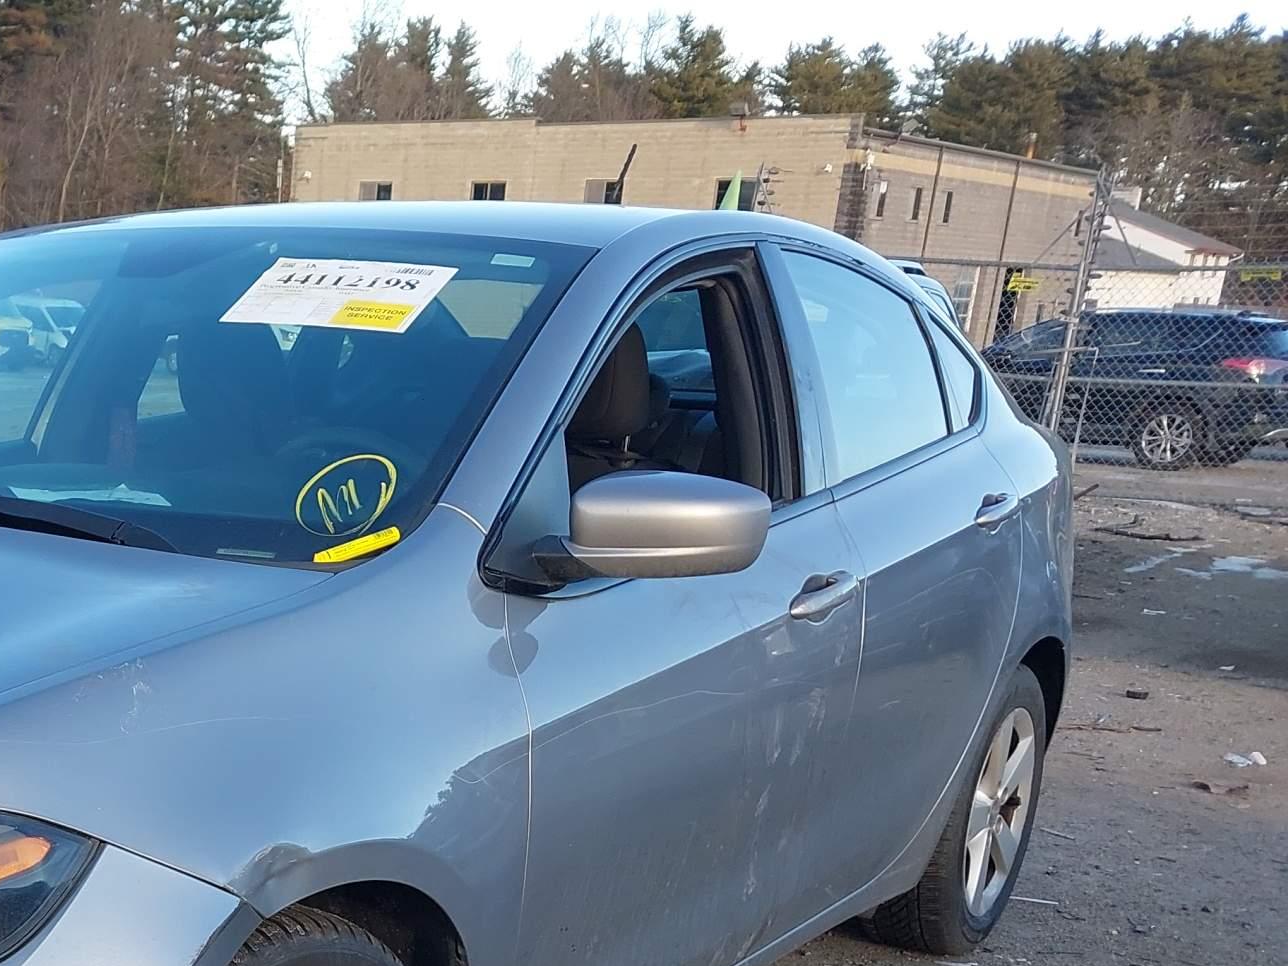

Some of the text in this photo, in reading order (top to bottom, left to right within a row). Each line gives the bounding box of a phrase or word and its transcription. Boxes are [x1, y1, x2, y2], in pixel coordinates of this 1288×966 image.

[276, 271, 421, 291] 44112198
[343, 306, 408, 316] INSPECTION
[346, 312, 394, 321] SERVICE
